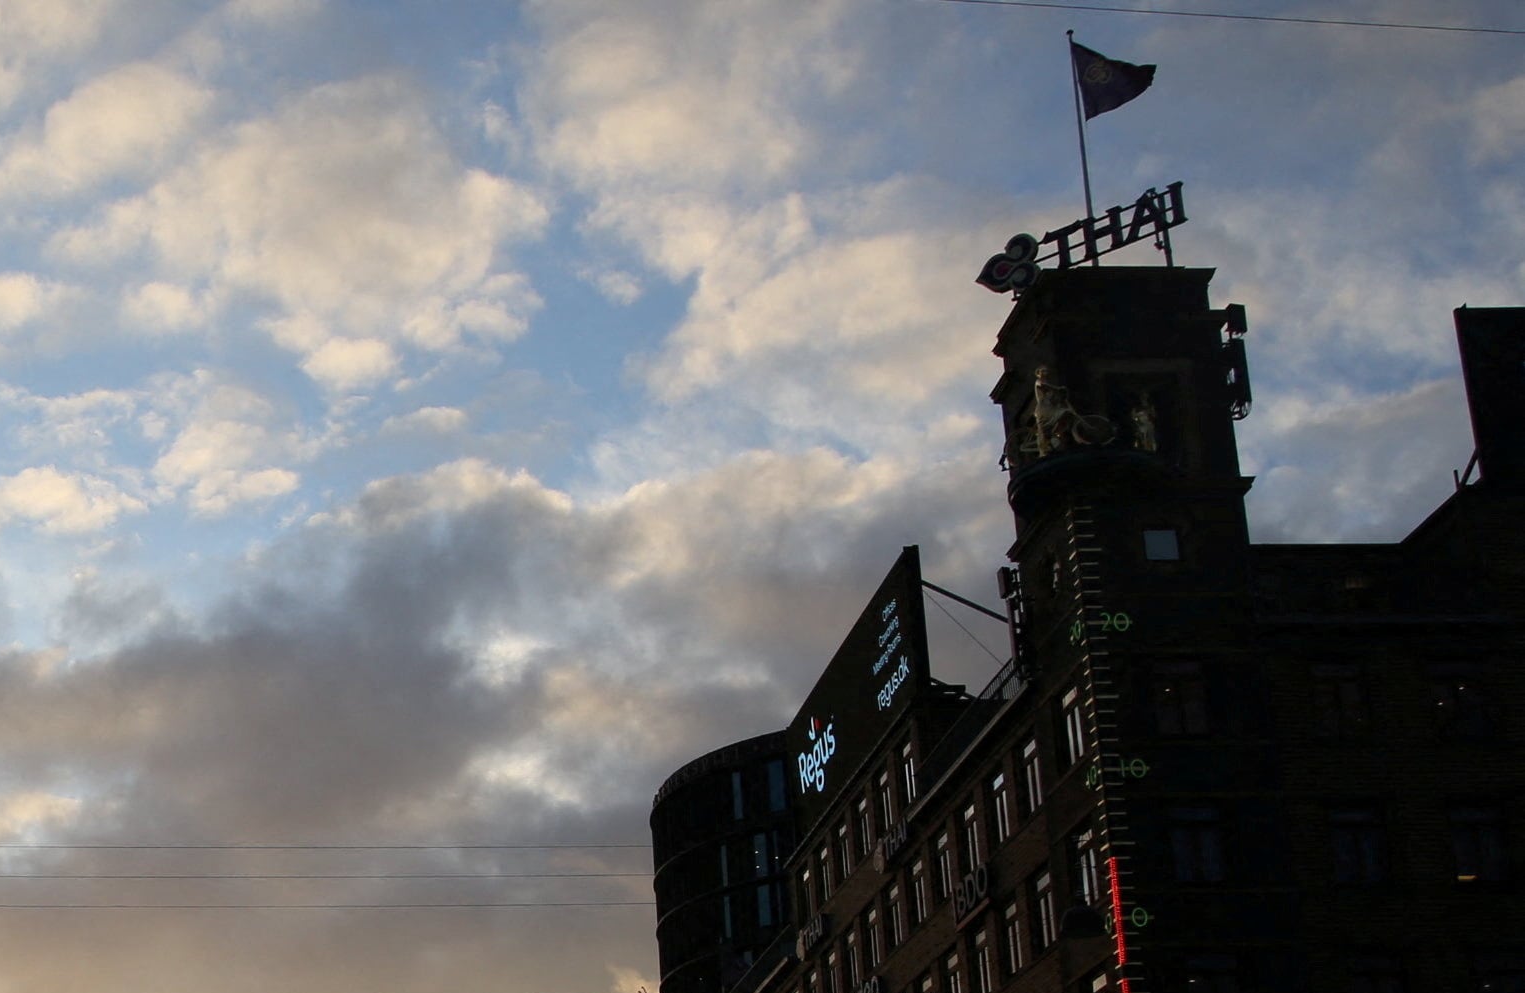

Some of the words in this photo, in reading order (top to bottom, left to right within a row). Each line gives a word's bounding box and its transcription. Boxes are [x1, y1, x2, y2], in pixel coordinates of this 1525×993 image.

[1043, 181, 1188, 270] THAI
[1099, 612, 1130, 632] 20
[797, 723, 836, 794] Regus
[1120, 758, 1148, 779] 10
[955, 863, 988, 921] BDO
[1131, 907, 1149, 928] 0
